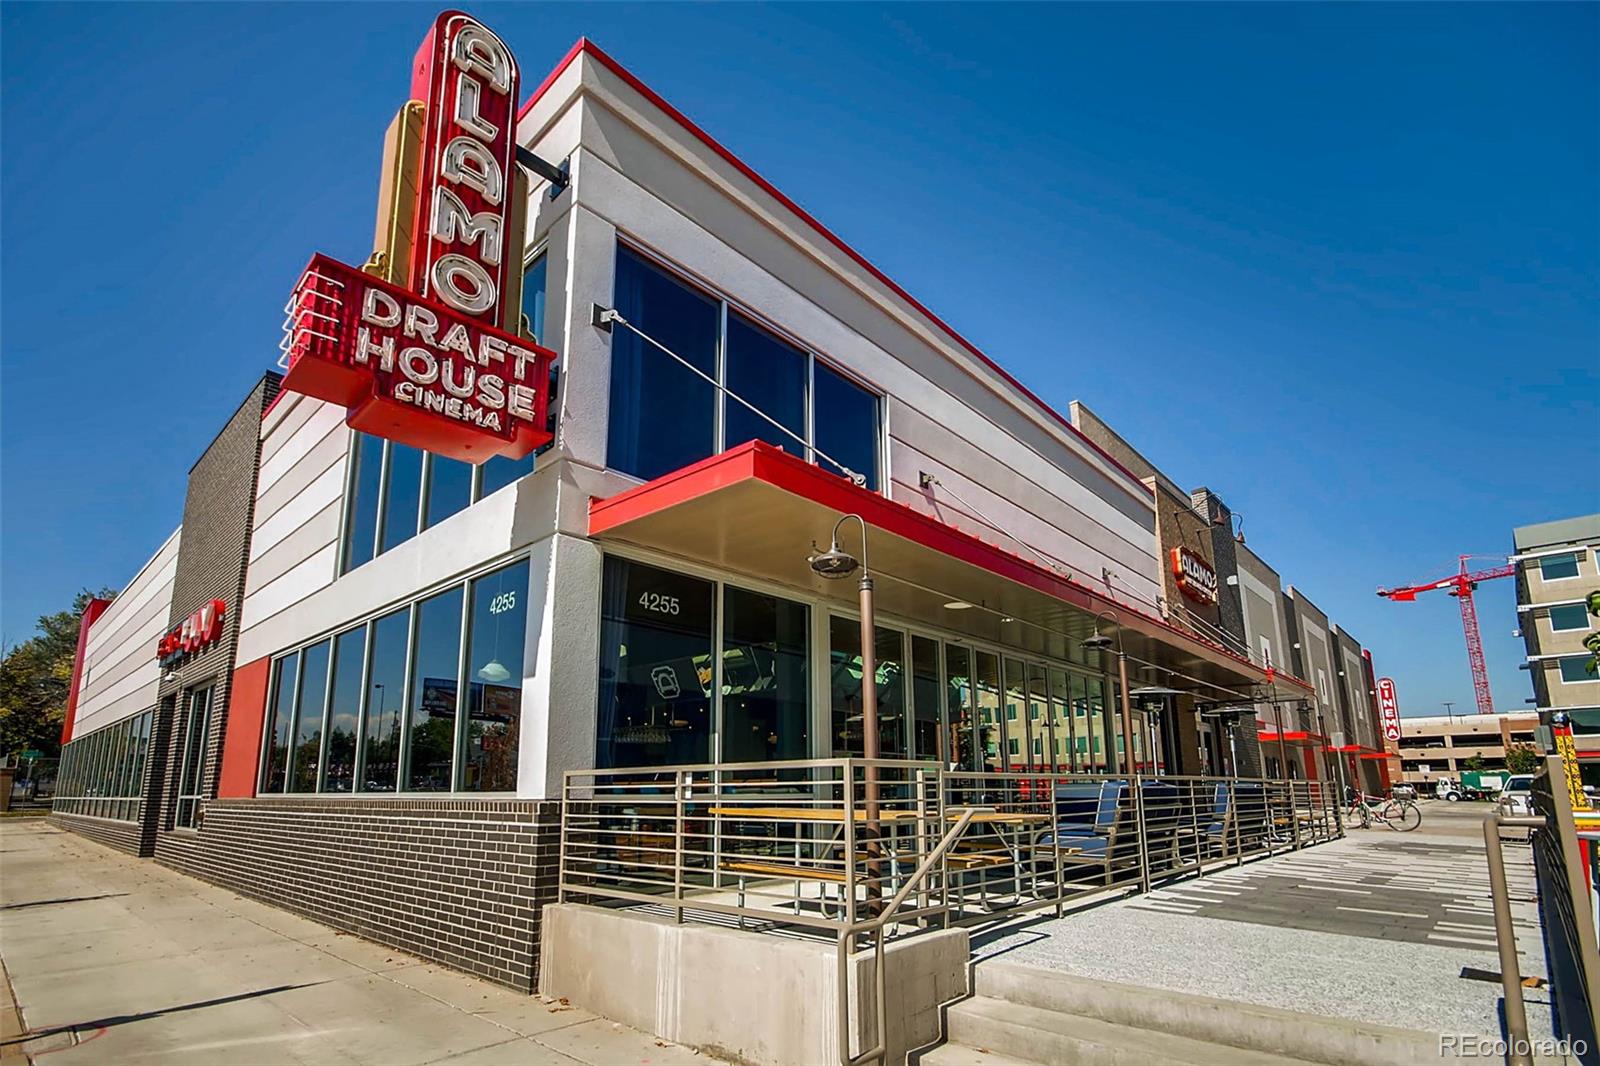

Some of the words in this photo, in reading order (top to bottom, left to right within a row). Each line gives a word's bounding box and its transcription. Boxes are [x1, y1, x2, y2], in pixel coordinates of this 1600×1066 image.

[432, 23, 511, 315] ALAMO
[361, 287, 536, 381] DRAFT
[355, 327, 536, 422] HOUSE
[394, 382, 502, 432] CINEMA
[1182, 554, 1213, 588] ALAMO
[489, 591, 516, 615] 4255
[638, 591, 680, 616] 4255
[1380, 680, 1399, 737] CINEMA
